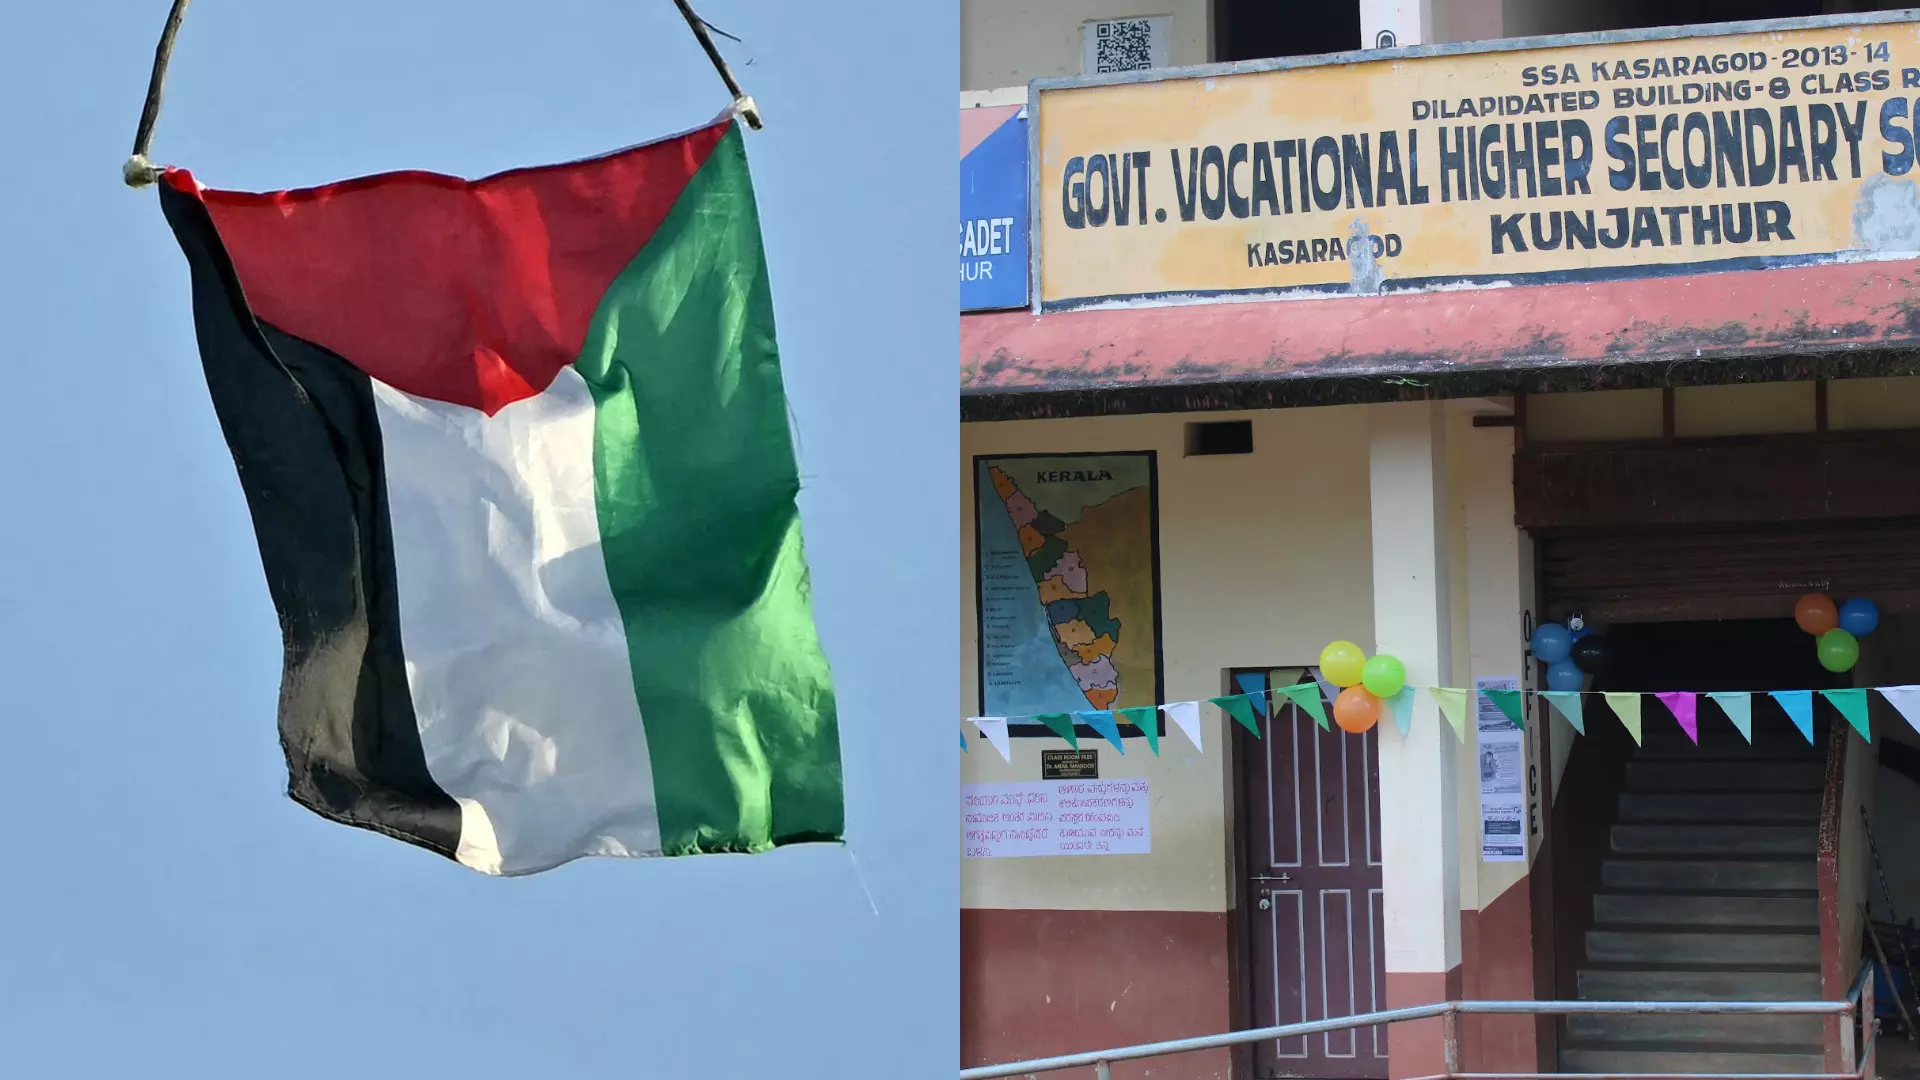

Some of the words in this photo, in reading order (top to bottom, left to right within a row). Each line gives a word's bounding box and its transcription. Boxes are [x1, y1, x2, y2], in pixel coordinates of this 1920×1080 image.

[1412, 90, 1600, 121] DILAPIDATED
[1801, 69, 1891, 95] CLASS
[1522, 63, 1581, 88] SSA
[1062, 151, 1168, 229] GOVT.
[1170, 128, 1429, 223] VOCATIONAL
[1439, 118, 1592, 203] HIGHER
[1605, 100, 1868, 192] SECONDARY
[1879, 97, 1920, 177] S
[1490, 200, 1796, 255] KUNJATHUR
[1037, 469, 1114, 484] KERALA
